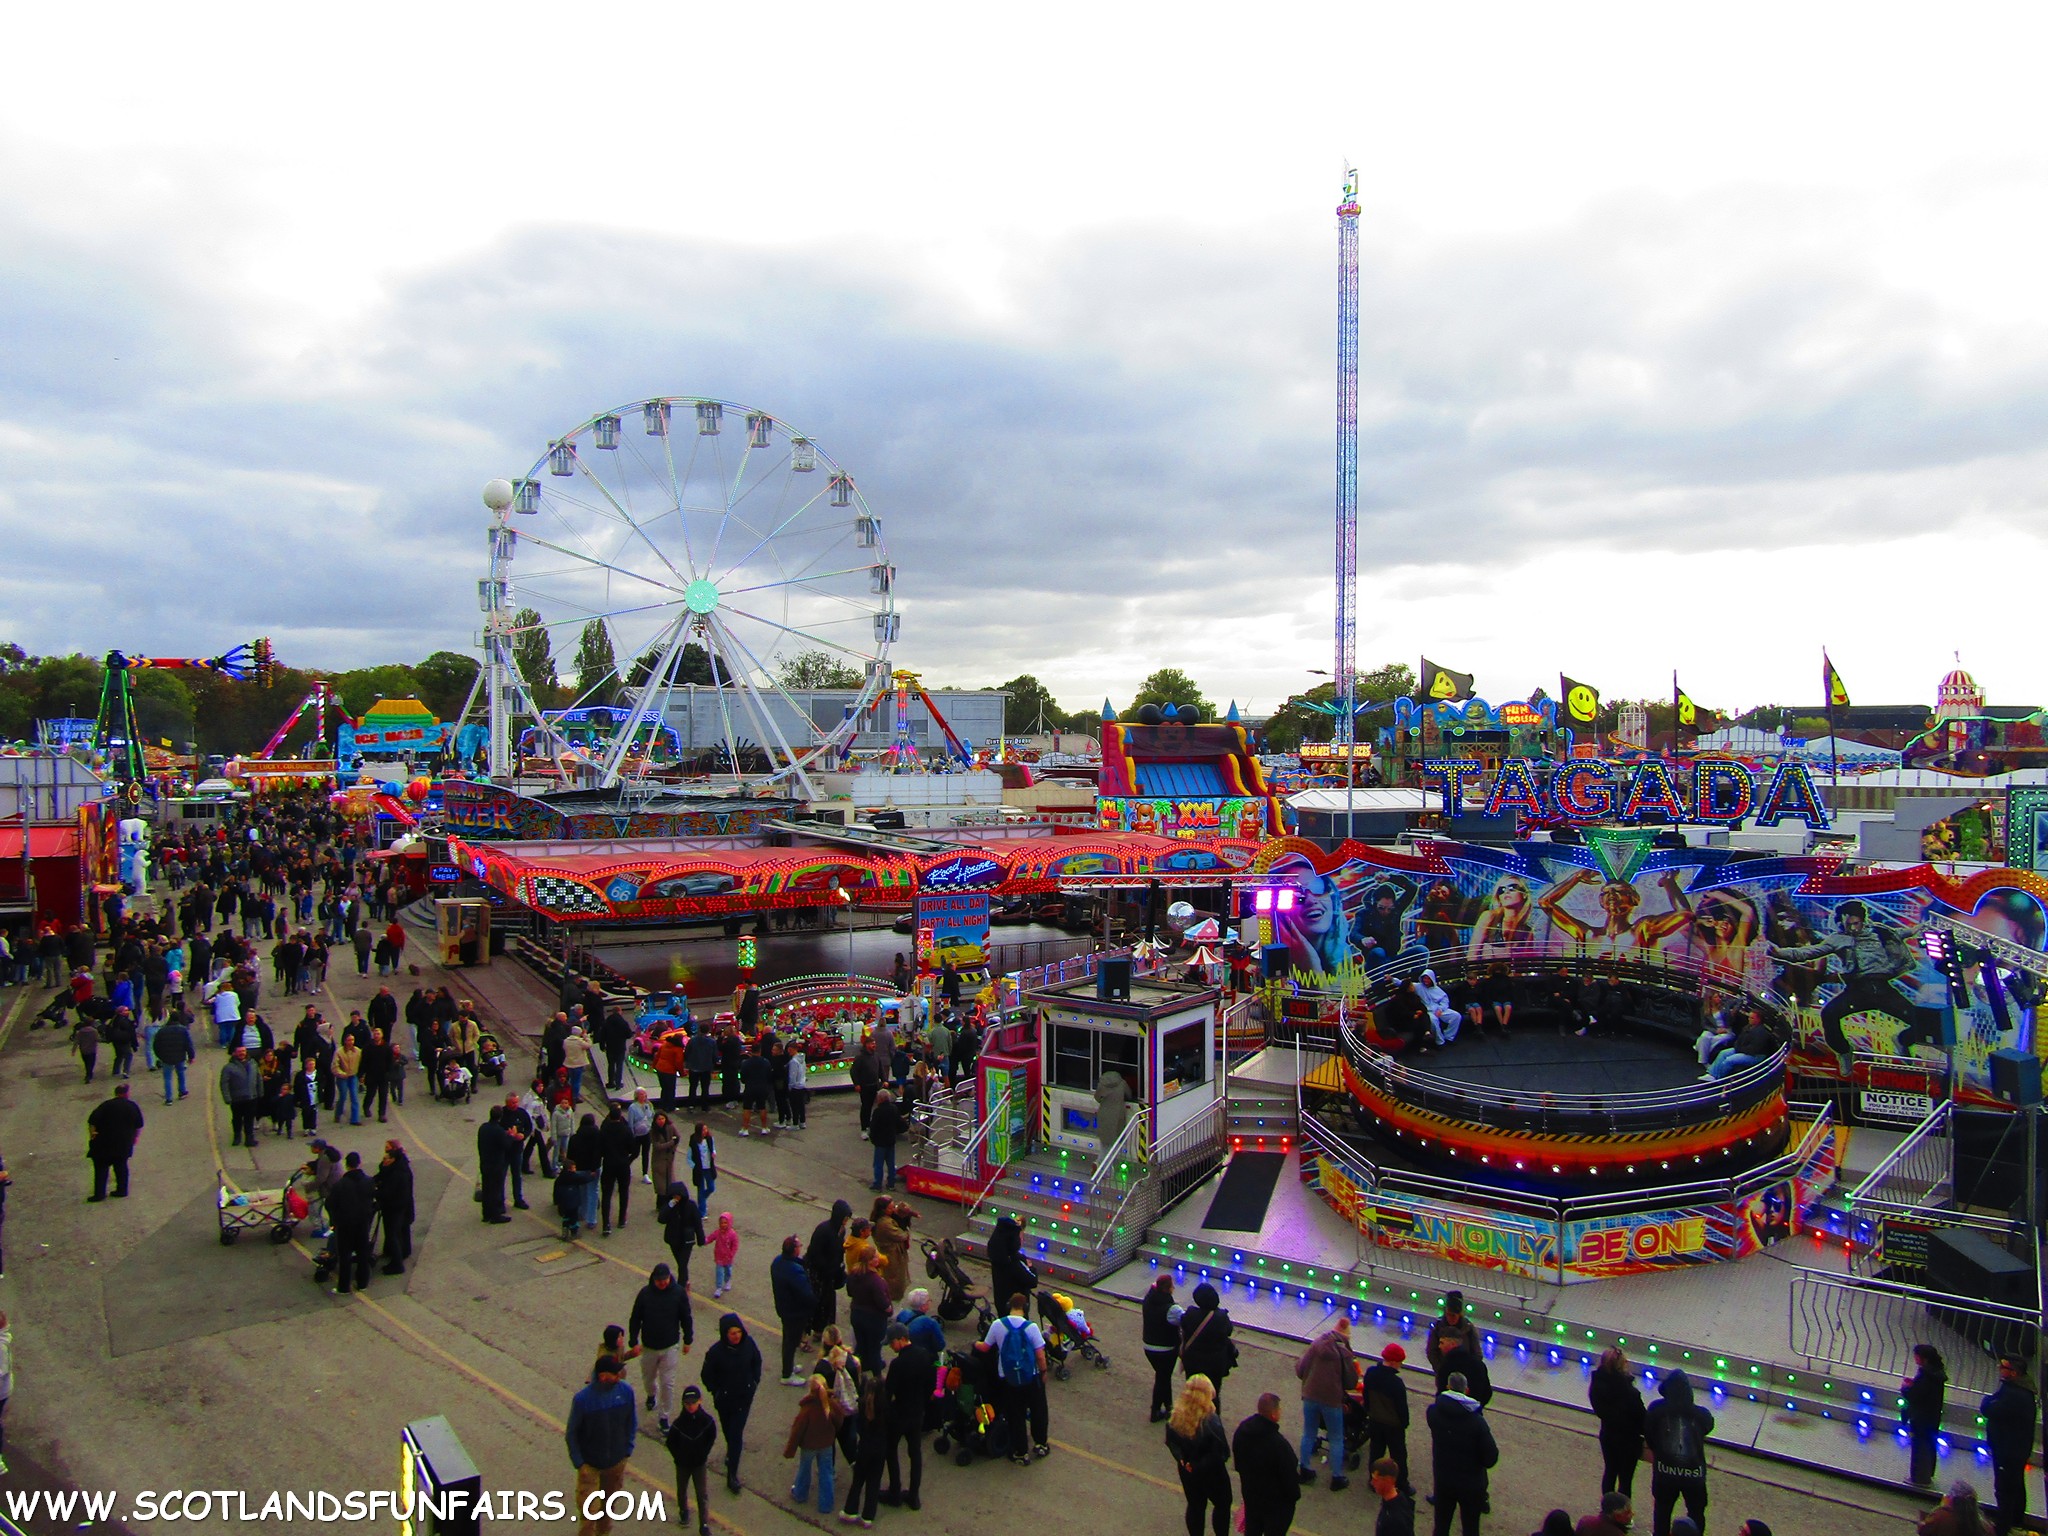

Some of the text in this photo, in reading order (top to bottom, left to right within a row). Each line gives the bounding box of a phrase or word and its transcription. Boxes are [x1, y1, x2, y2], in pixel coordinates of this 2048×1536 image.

[612, 712, 659, 722] MAESS
[1505, 705, 1528, 715] FUN
[1506, 714, 1540, 724] HOUSE
[52, 731, 93, 740] PWER
[355, 728, 424, 745] ICE MAZE
[1423, 758, 1832, 831] TAGADA
[1178, 801, 1220, 826] XXL
[927, 857, 997, 884] Road House
[617, 872, 643, 886] ROUTE
[610, 886, 631, 901] 66
[921, 897, 986, 912] DRIVE ALL DAY
[920, 914, 987, 929] PARTY ALL NIGHT
[1290, 1001, 1309, 1016] EXIT
[1866, 1093, 1928, 1107] NOTICE
[1461, 1217, 1557, 1268] ONLY
[1577, 1226, 1630, 1268] BE
[1632, 1216, 1708, 1259] ONE
